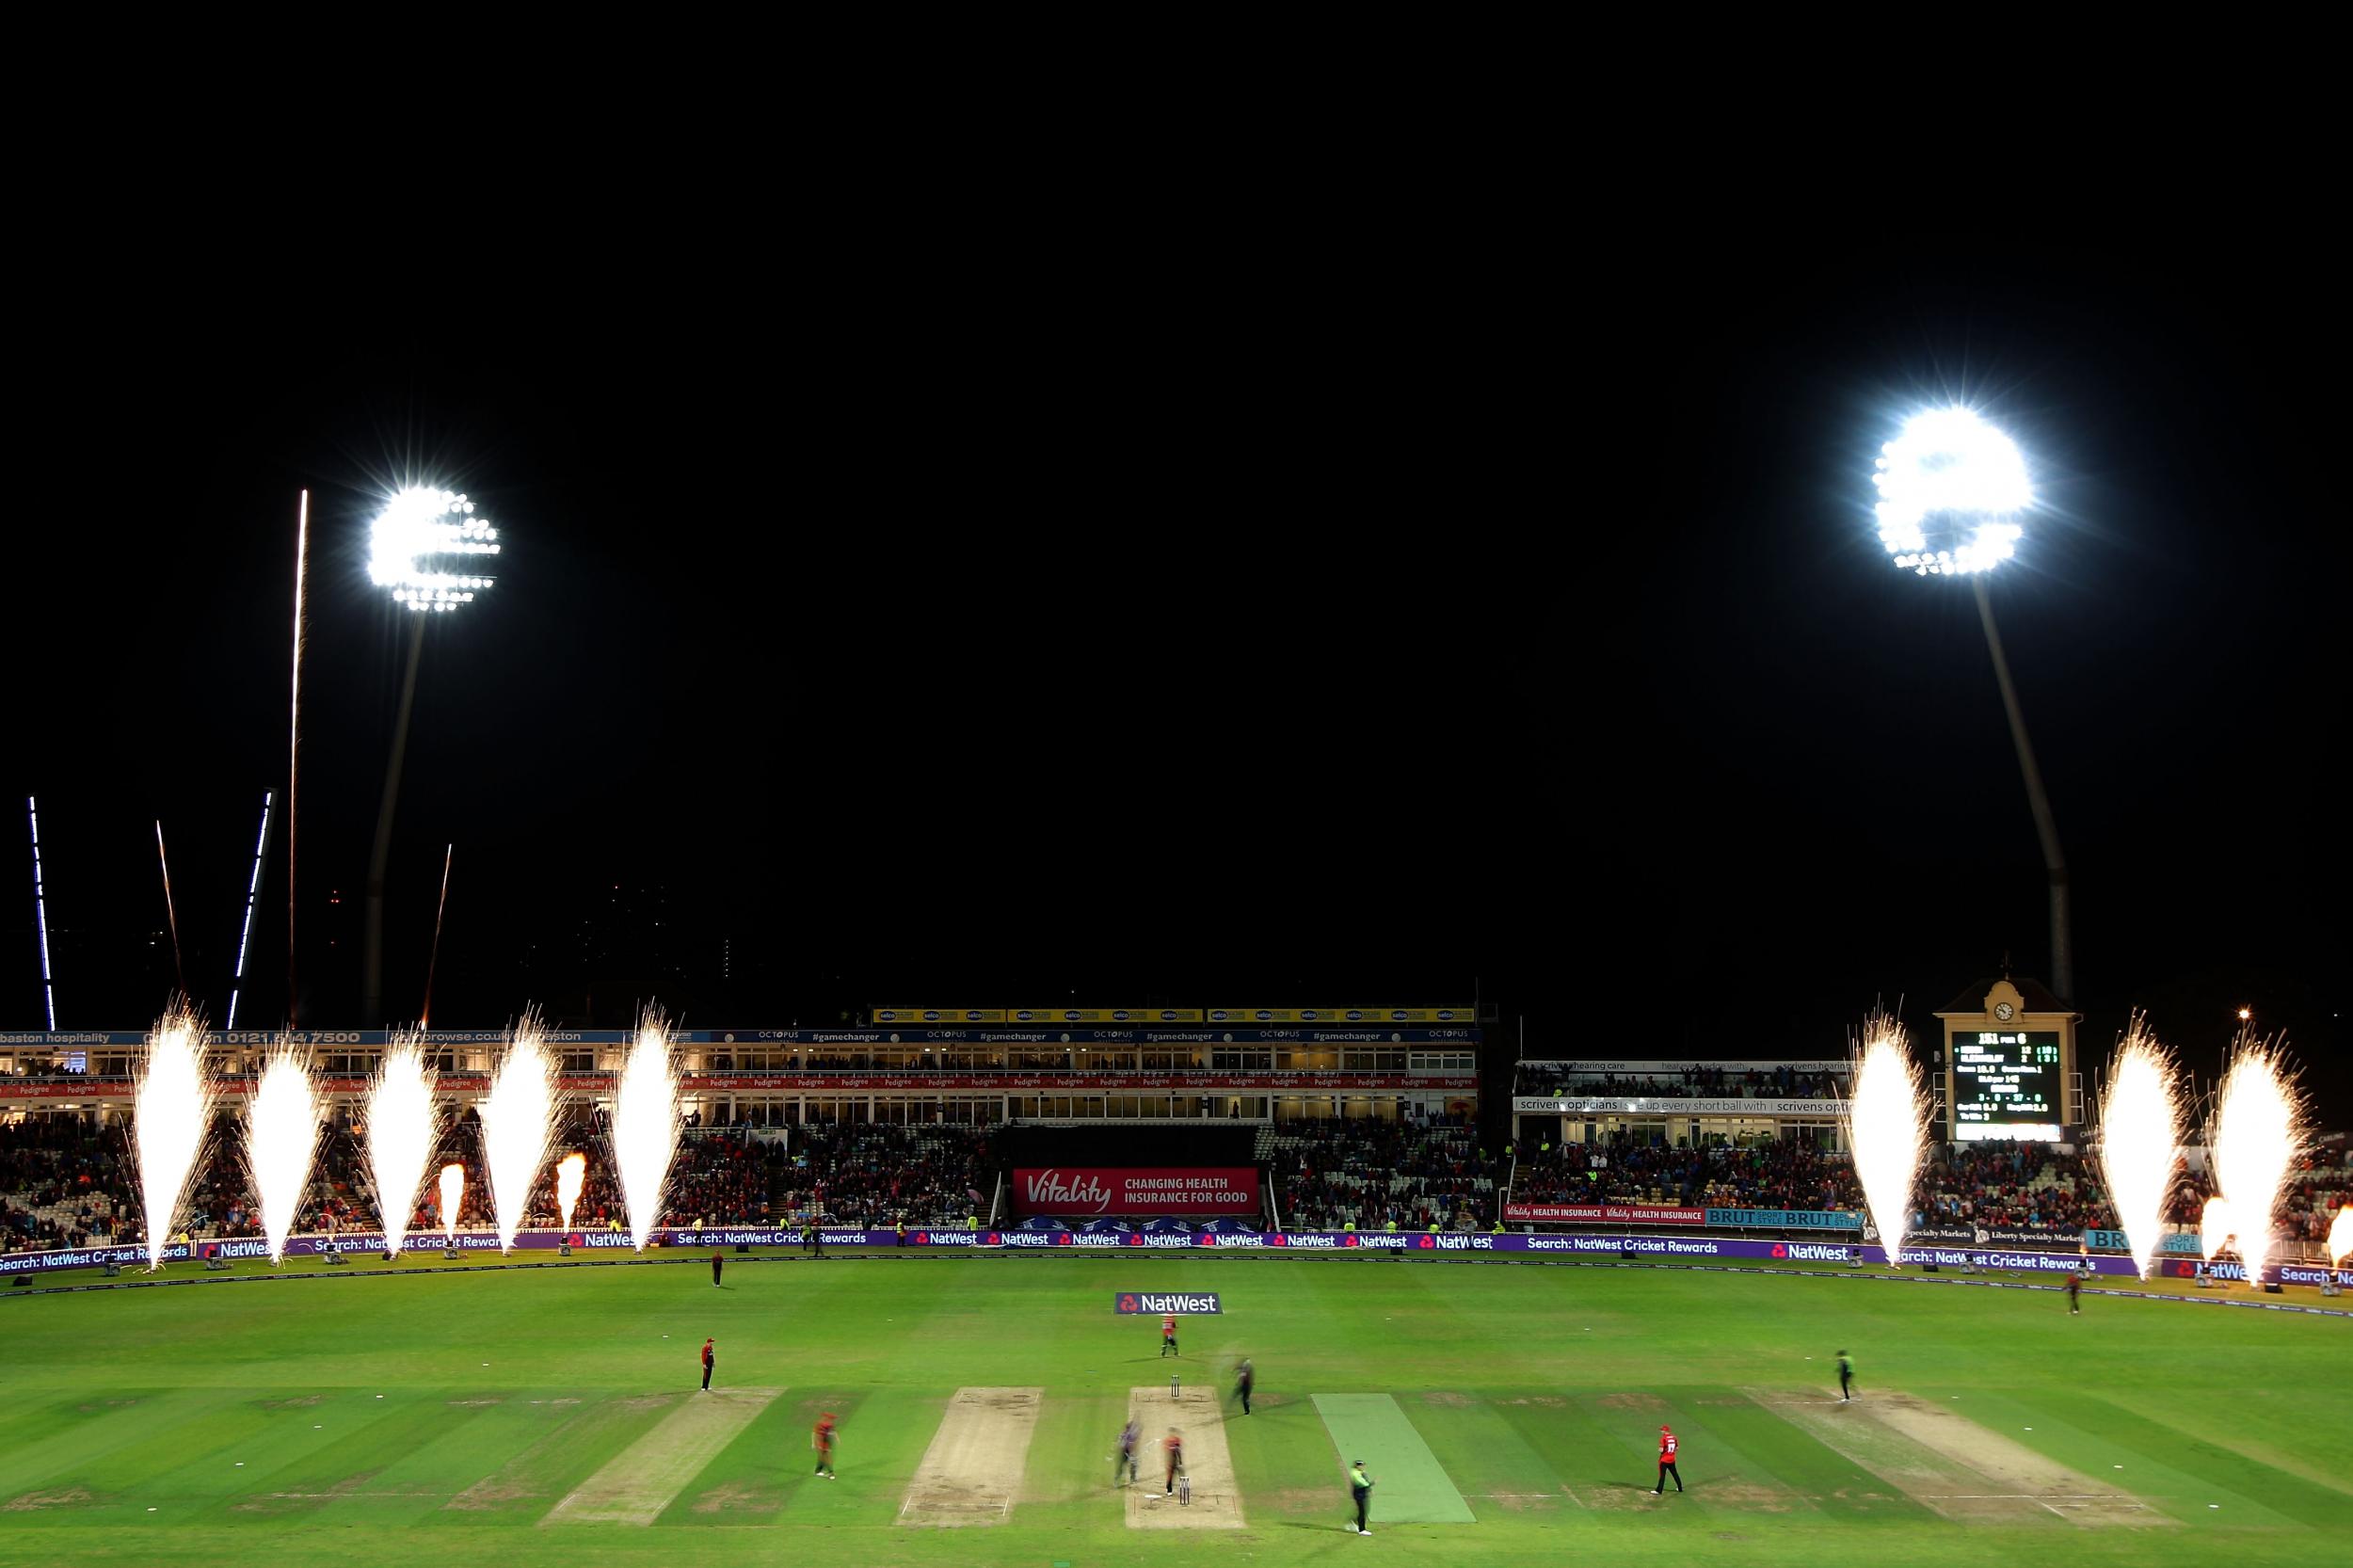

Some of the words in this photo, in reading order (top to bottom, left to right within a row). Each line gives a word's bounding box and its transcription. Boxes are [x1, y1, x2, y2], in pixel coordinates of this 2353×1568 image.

[0, 1033, 42, 1043] baston
[47, 1032, 110, 1045] hospitality
[227, 1033, 268, 1043] 0121
[311, 1032, 360, 1043] 7500
[812, 1032, 879, 1042] #gamechanger
[980, 1032, 1047, 1042] #gamechanger
[1146, 1032, 1212, 1042] #gamechanger
[1313, 1032, 1381, 1042] #gamechanger
[1574, 1062, 1606, 1070] hearing
[443, 1080, 472, 1090] Pedigree
[577, 1080, 605, 1089] Pedigree
[711, 1079, 738, 1087] Pedigree
[754, 1079, 781, 1087] Pedigree
[798, 1079, 824, 1087] Pedigree
[841, 1079, 868, 1087] Pedigree
[885, 1079, 911, 1087] Pedigree
[928, 1079, 954, 1087] Pedigree
[971, 1079, 998, 1087] Pedigree
[1015, 1079, 1040, 1087] Pedigree
[1057, 1079, 1083, 1087] Pedigree
[1100, 1079, 1127, 1087] Pedigree
[1144, 1079, 1170, 1087] Pedigree
[1186, 1079, 1212, 1087] Pedigree
[1229, 1079, 1256, 1087] Pedigree
[1272, 1079, 1298, 1087] Pedigree
[1315, 1079, 1341, 1087] Pedigree
[1358, 1079, 1385, 1087] Pedigree
[1401, 1079, 1428, 1087] Pedigree
[1445, 1079, 1472, 1087] Pedigree
[20, 1085, 49, 1096] Pedigree
[67, 1085, 95, 1095] Pedigree
[1567, 1099, 1617, 1111] opticians
[1646, 1103, 1659, 1112] up
[1662, 1103, 1690, 1112] every
[1693, 1101, 1720, 1111] short
[1722, 1100, 1741, 1111] ball
[1744, 1100, 1767, 1111] with
[1777, 1101, 1823, 1112] scrivens
[1125, 1178, 1183, 1189] CHANGING
[1186, 1178, 1228, 1189] HEALTH
[1028, 1168, 1112, 1213] Vitality
[1125, 1192, 1188, 1203] INSURANCE
[1191, 1192, 1212, 1203] FOR
[1215, 1192, 1248, 1203] GOOD
[1507, 1205, 1530, 1218] Vitality
[1532, 1208, 1559, 1217] HEALTH
[1561, 1209, 1602, 1218] INSURANCE
[1607, 1207, 1630, 1220] Vitality
[1632, 1210, 1658, 1219] HEALTH
[1661, 1210, 1702, 1220] INSURANCE
[1708, 1210, 1754, 1224] BRUT
[1785, 1212, 1833, 1226] BRUT
[585, 1233, 635, 1247] NatWes
[725, 1233, 771, 1243] NatWest
[819, 1232, 866, 1243] Rewards
[930, 1233, 977, 1244] NatWest
[1001, 1233, 1048, 1245] NatWest
[1073, 1234, 1120, 1245] NatWest
[1144, 1234, 1192, 1246] NatWest
[1216, 1234, 1263, 1246] NatWest
[1288, 1235, 1335, 1247] NatWest
[1359, 1236, 1406, 1247] NatWest
[1992, 1231, 2018, 1240] Liberty
[2019, 1232, 2053, 1242] Specialty
[2054, 1234, 2085, 1242] Markets
[365, 1238, 414, 1250] Natst
[1436, 1236, 1493, 1250] NatWest
[1528, 1237, 1572, 1249] Search:
[1575, 1239, 1621, 1250] NatWest
[1625, 1240, 1665, 1251] Cricket
[1668, 1240, 1718, 1254] Rewards
[2162, 1242, 2197, 1252] STYLE
[220, 1242, 271, 1257] NatWes
[1788, 1244, 1848, 1260] NatWest
[0, 1256, 40, 1271] Search:
[42, 1253, 90, 1267] NatWest
[137, 1246, 187, 1260] Reards
[1936, 1251, 1988, 1265] NatWst
[1990, 1254, 2037, 1268] Cricket
[2281, 1268, 2329, 1282] Search
[1141, 1295, 1216, 1311] NatWest
